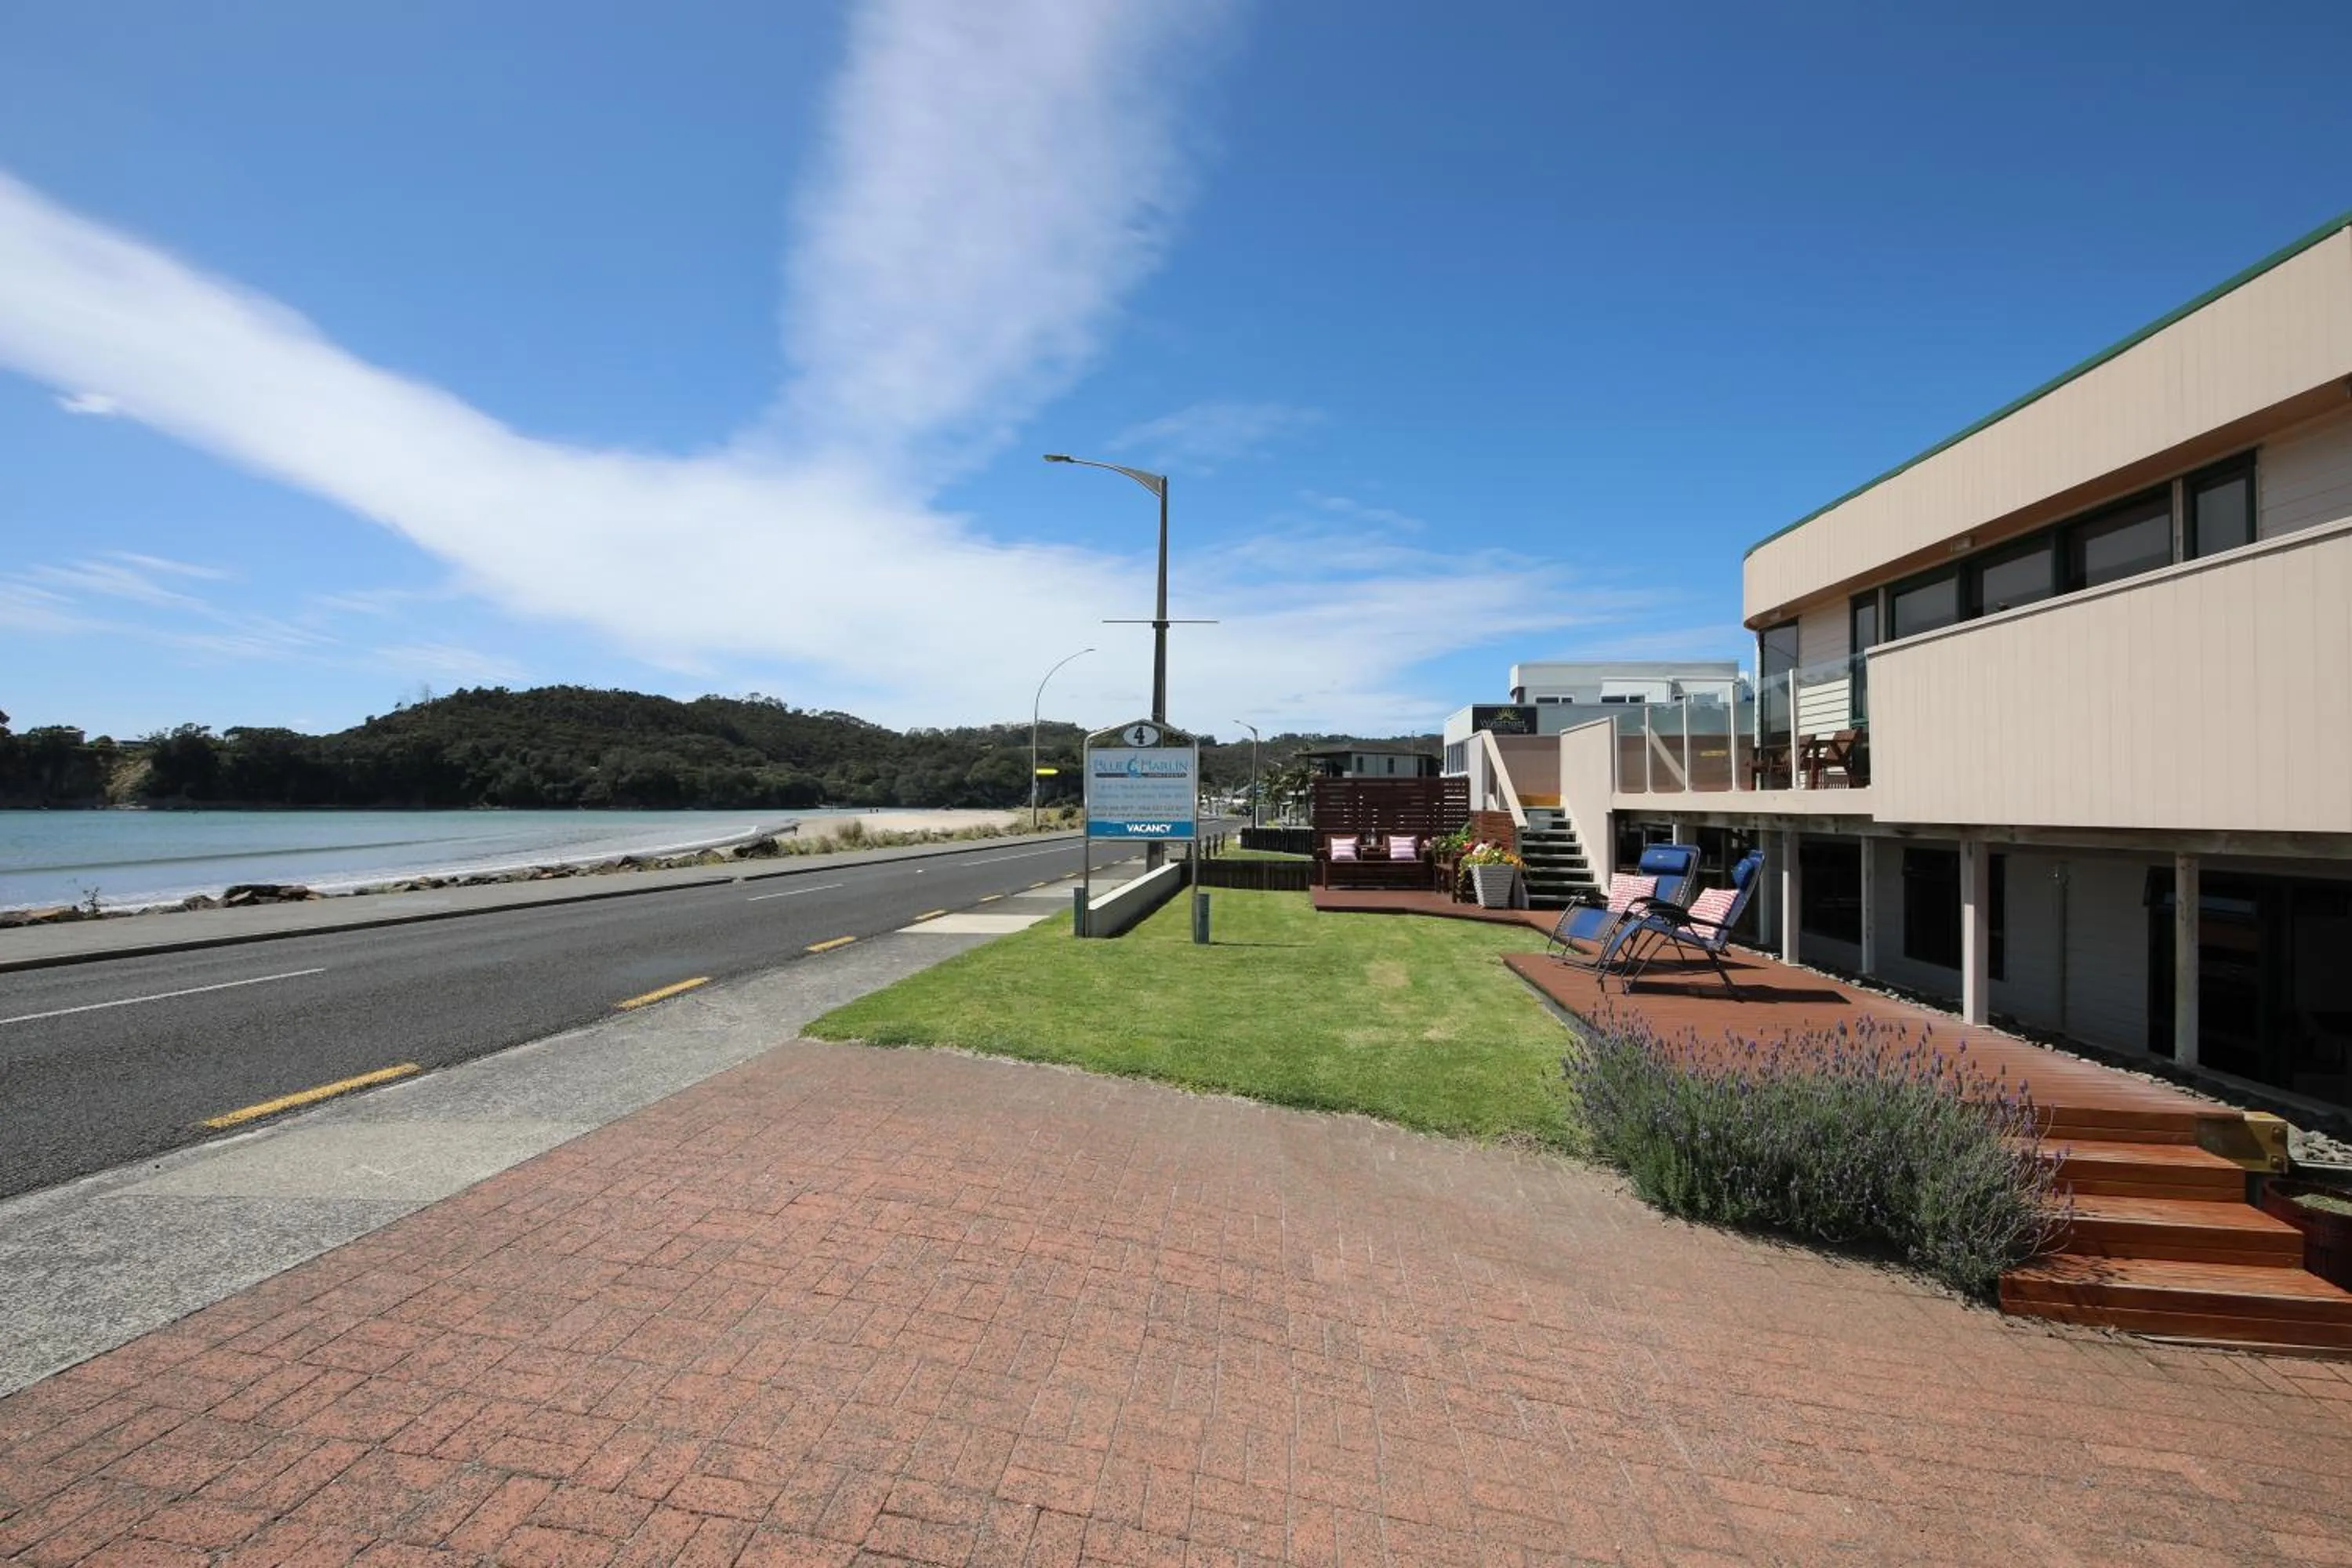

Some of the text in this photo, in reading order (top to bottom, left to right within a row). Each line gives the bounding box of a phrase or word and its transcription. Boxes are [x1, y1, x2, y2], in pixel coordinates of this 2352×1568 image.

[1134, 727, 1145, 745] 4
[1141, 759, 1188, 771] MARLIN
[1127, 824, 1172, 833] VACANCY
